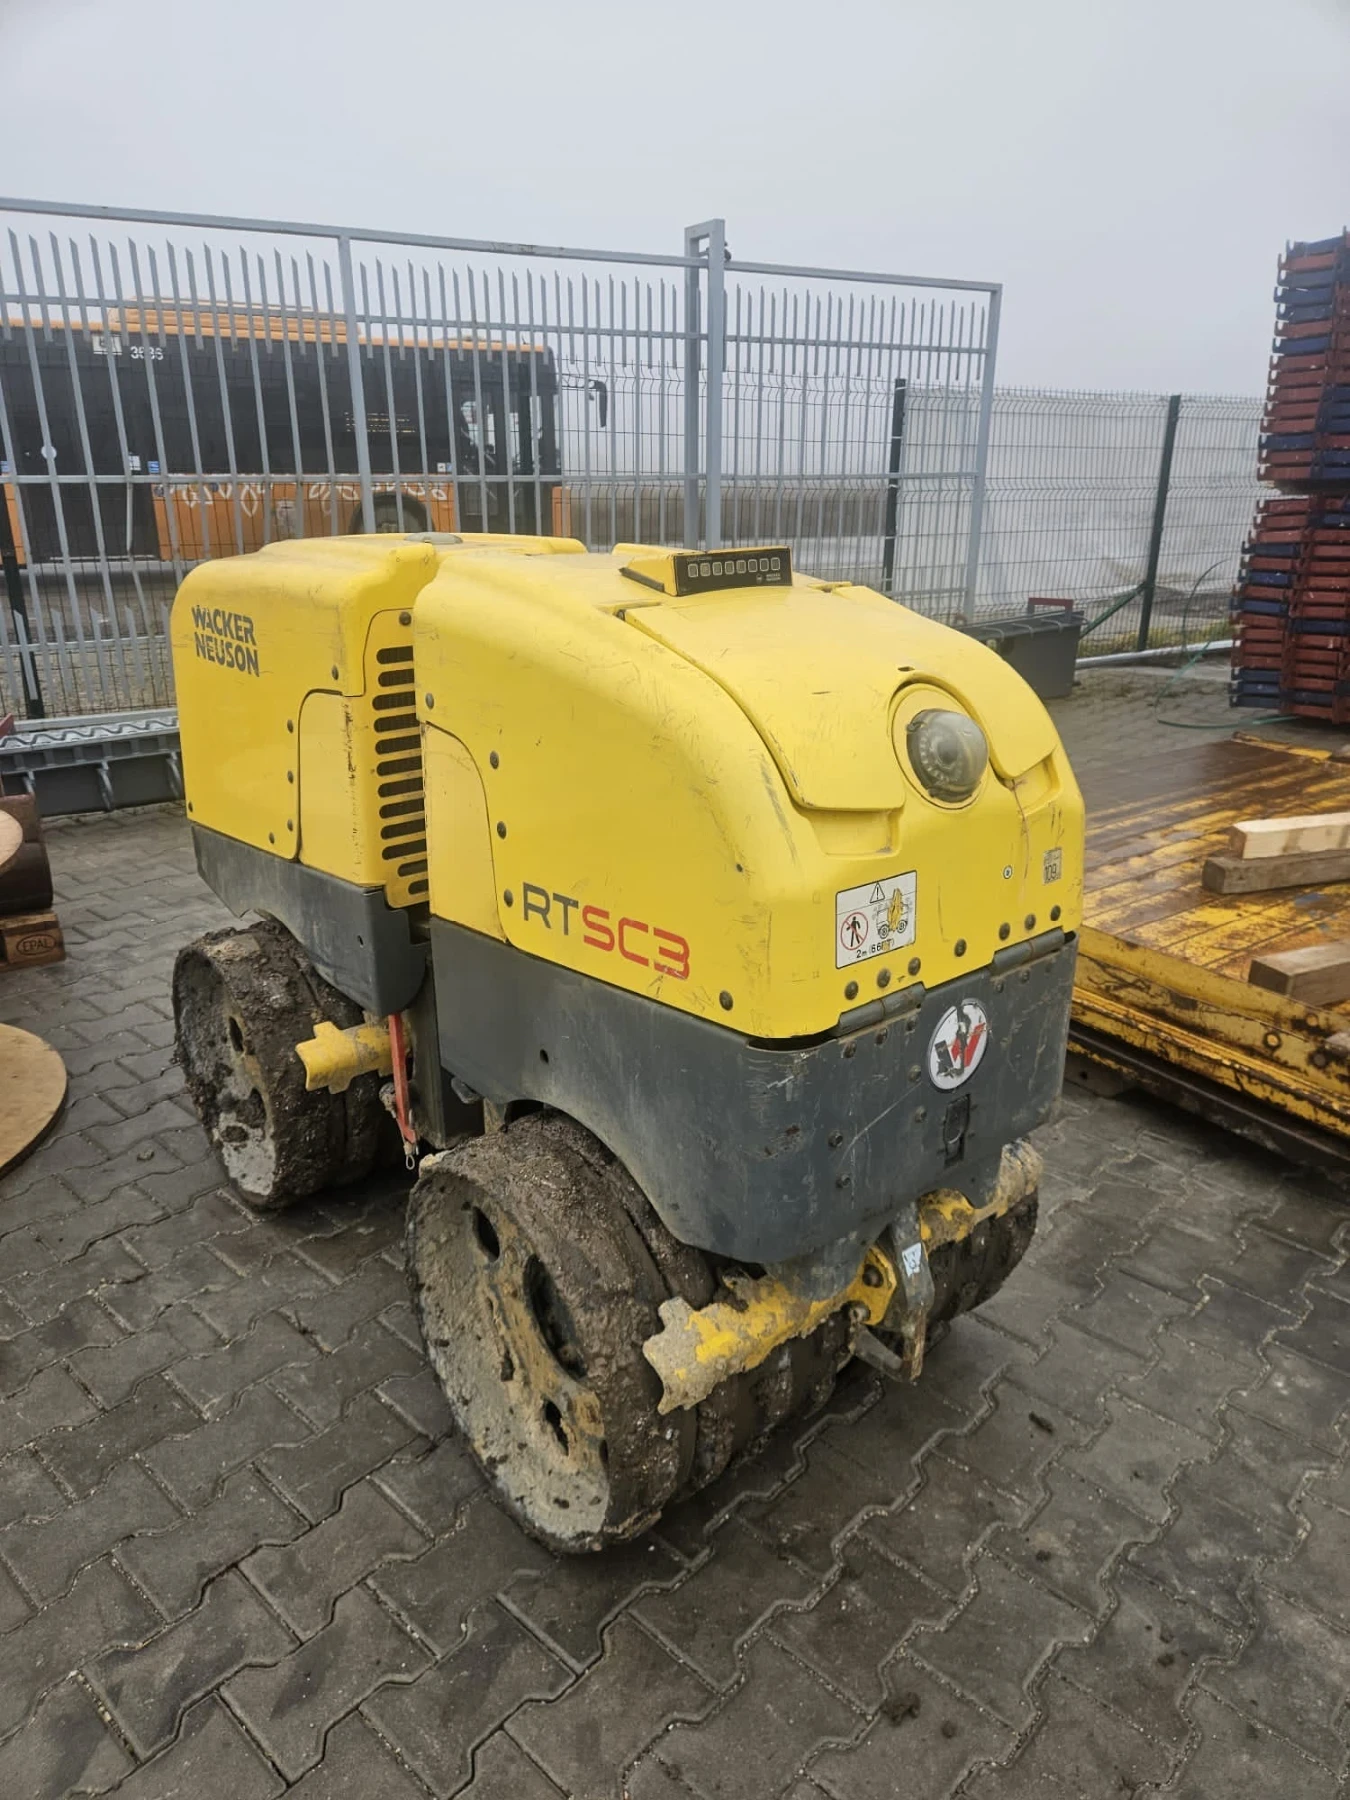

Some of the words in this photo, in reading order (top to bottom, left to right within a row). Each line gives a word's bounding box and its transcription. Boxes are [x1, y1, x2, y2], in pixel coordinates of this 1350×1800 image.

[191, 605, 257, 646] WACKER
[194, 631, 260, 678] NEUSON
[23, 938, 53, 952] EPAL
[522, 881, 690, 980] RTSC3
